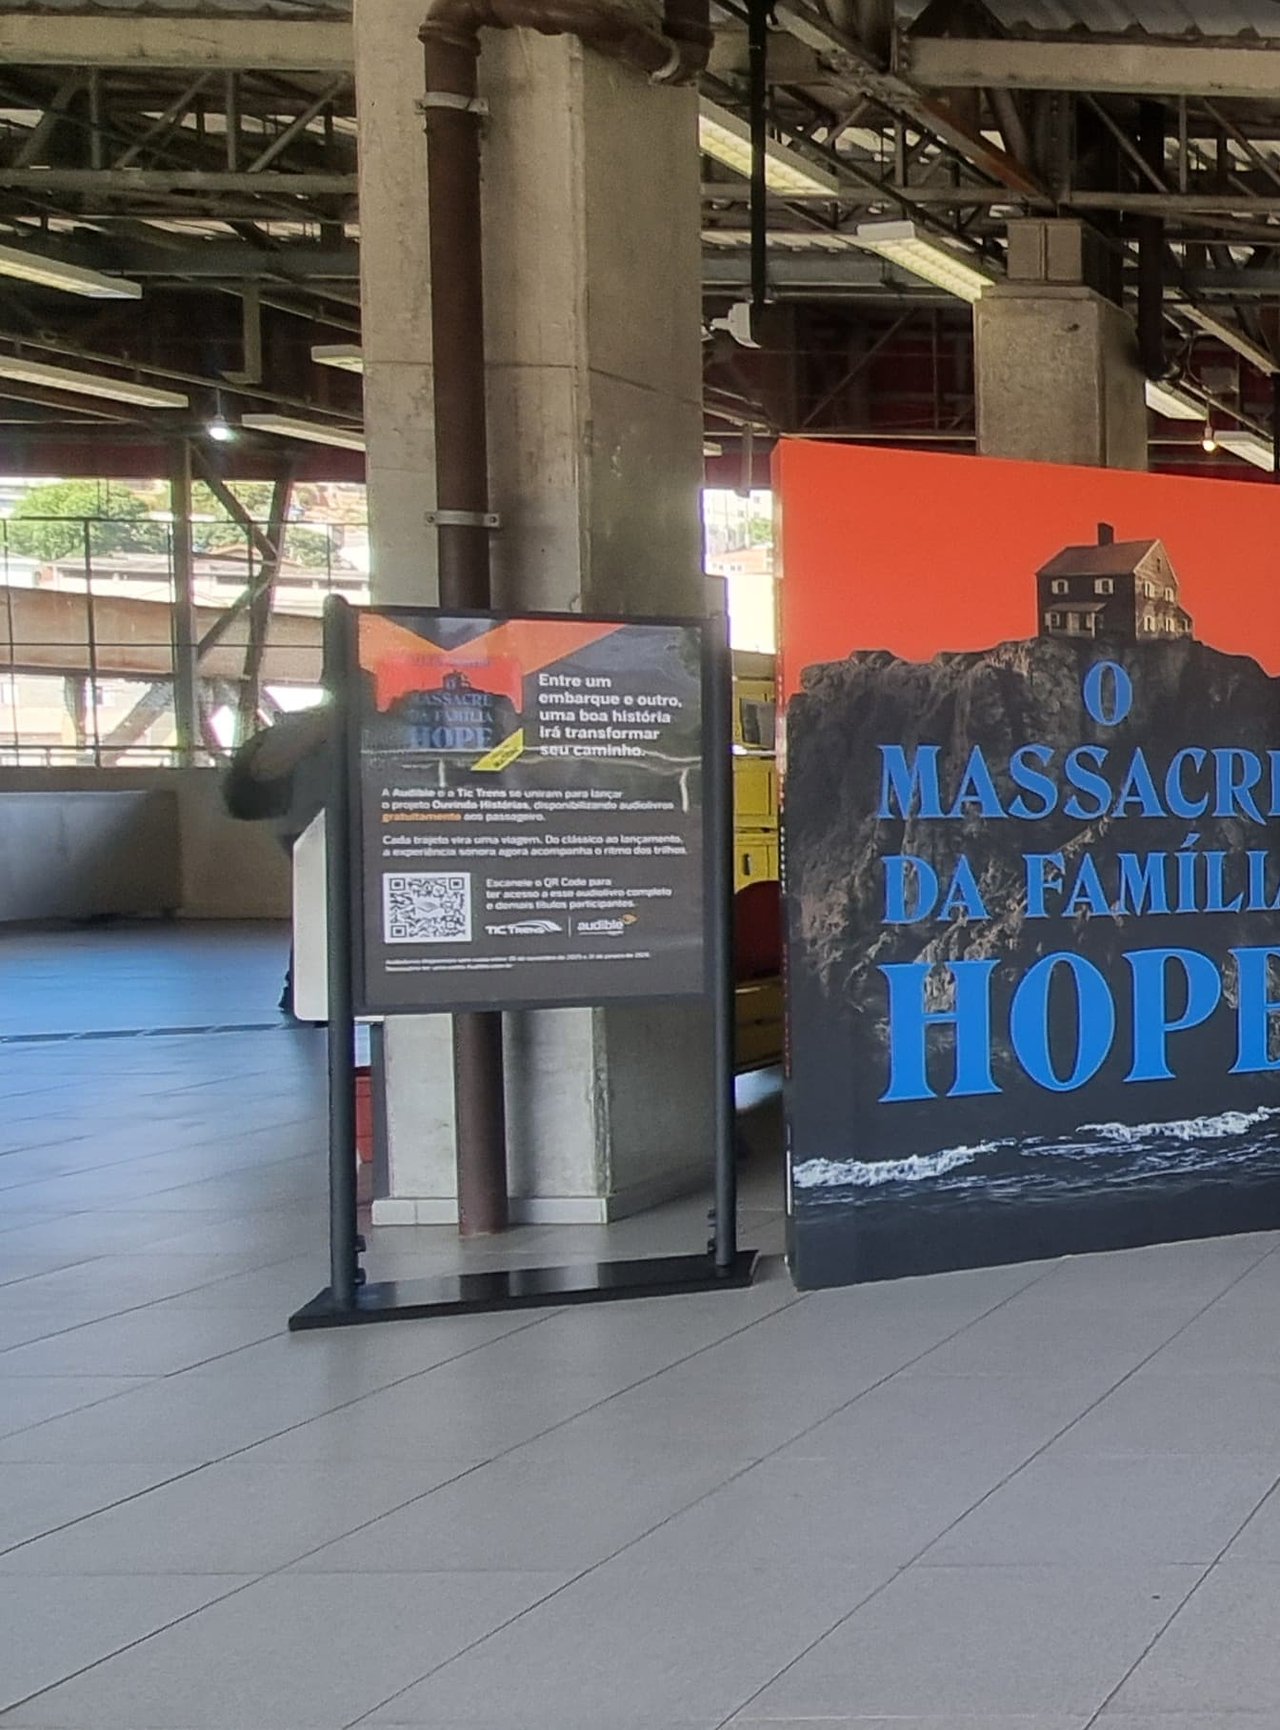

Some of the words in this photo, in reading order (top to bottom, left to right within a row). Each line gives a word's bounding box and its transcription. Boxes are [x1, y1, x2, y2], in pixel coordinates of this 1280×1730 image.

[539, 674, 581, 687] Entre
[585, 677, 611, 688] um
[539, 692, 619, 707] embarque
[624, 696, 633, 705] e
[638, 694, 682, 708] outro,
[1081, 660, 1134, 727] O
[539, 710, 575, 721] uma
[580, 709, 608, 721] boa
[612, 709, 671, 723] história
[540, 725, 560, 738] irá
[565, 726, 660, 739] transformar
[540, 745, 569, 755] seu
[573, 744, 646, 757] caminho.
[882, 853, 988, 925] DA
